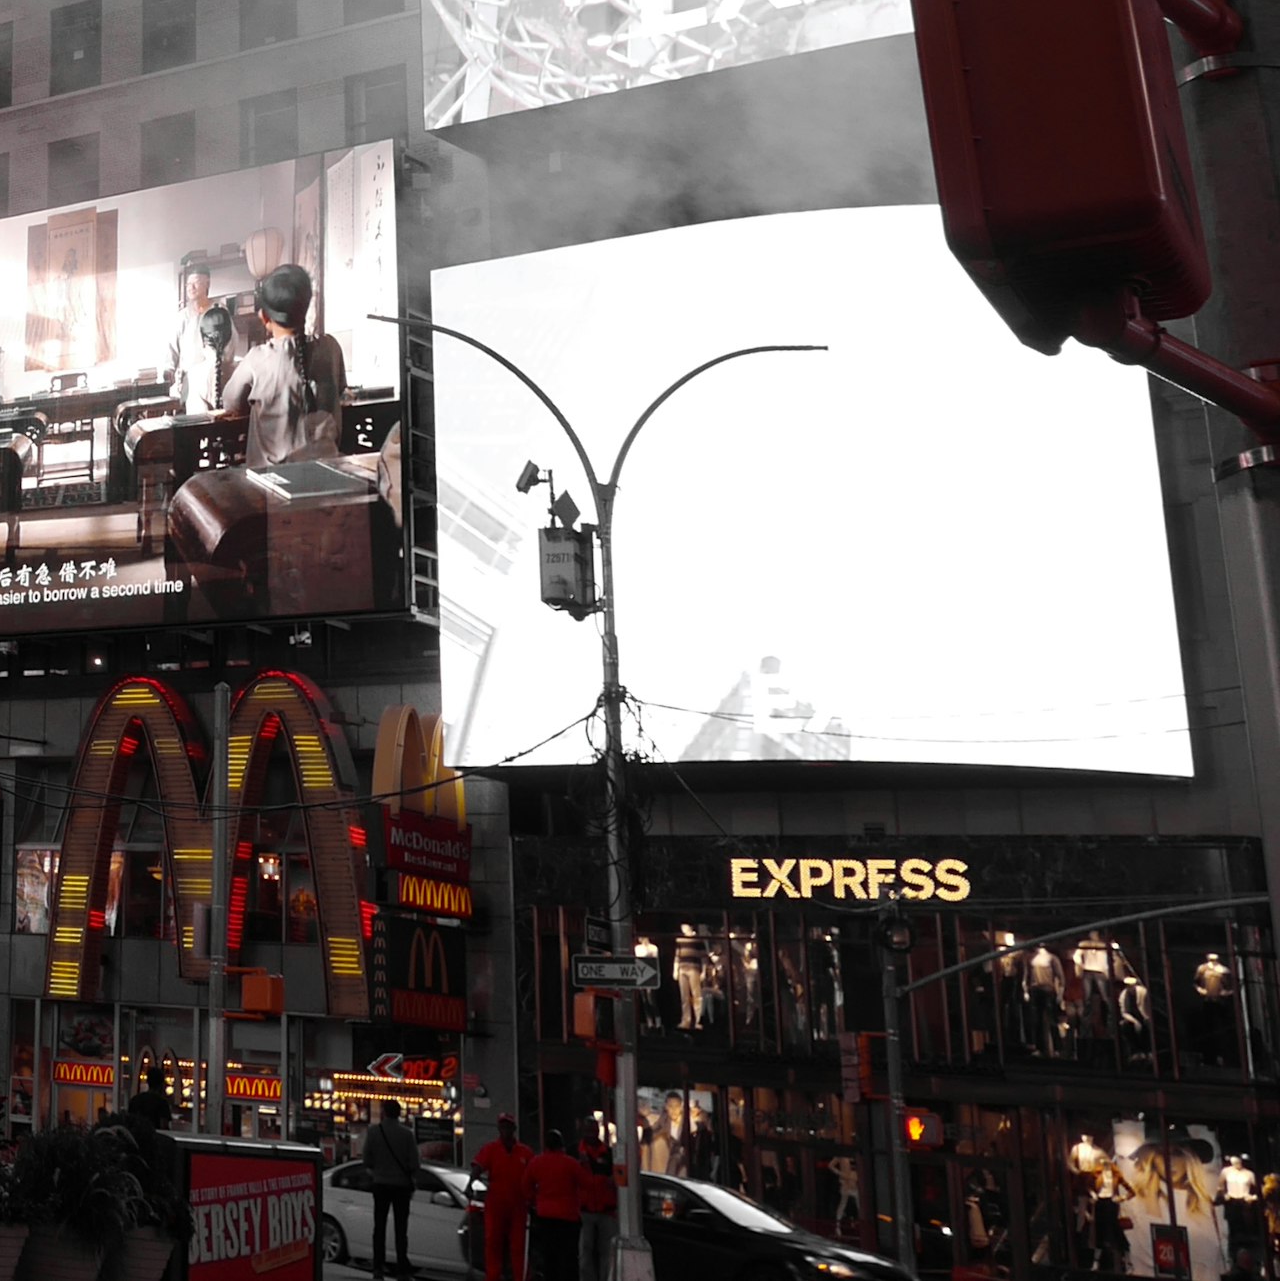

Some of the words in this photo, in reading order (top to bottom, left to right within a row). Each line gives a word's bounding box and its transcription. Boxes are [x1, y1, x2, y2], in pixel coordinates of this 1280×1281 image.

[28, 587, 41, 604] to
[43, 585, 88, 603] borrow
[90, 585, 100, 599] a
[101, 578, 152, 598] second
[153, 576, 184, 594] time
[390, 825, 470, 862] McDonald's
[403, 850, 458, 873] Restaurant
[730, 857, 972, 902] EXPRESS
[580, 965, 606, 978] ONE
[619, 965, 647, 979] WAY
[187, 1197, 263, 1266] JERSEY
[266, 1188, 317, 1250] BOYS
